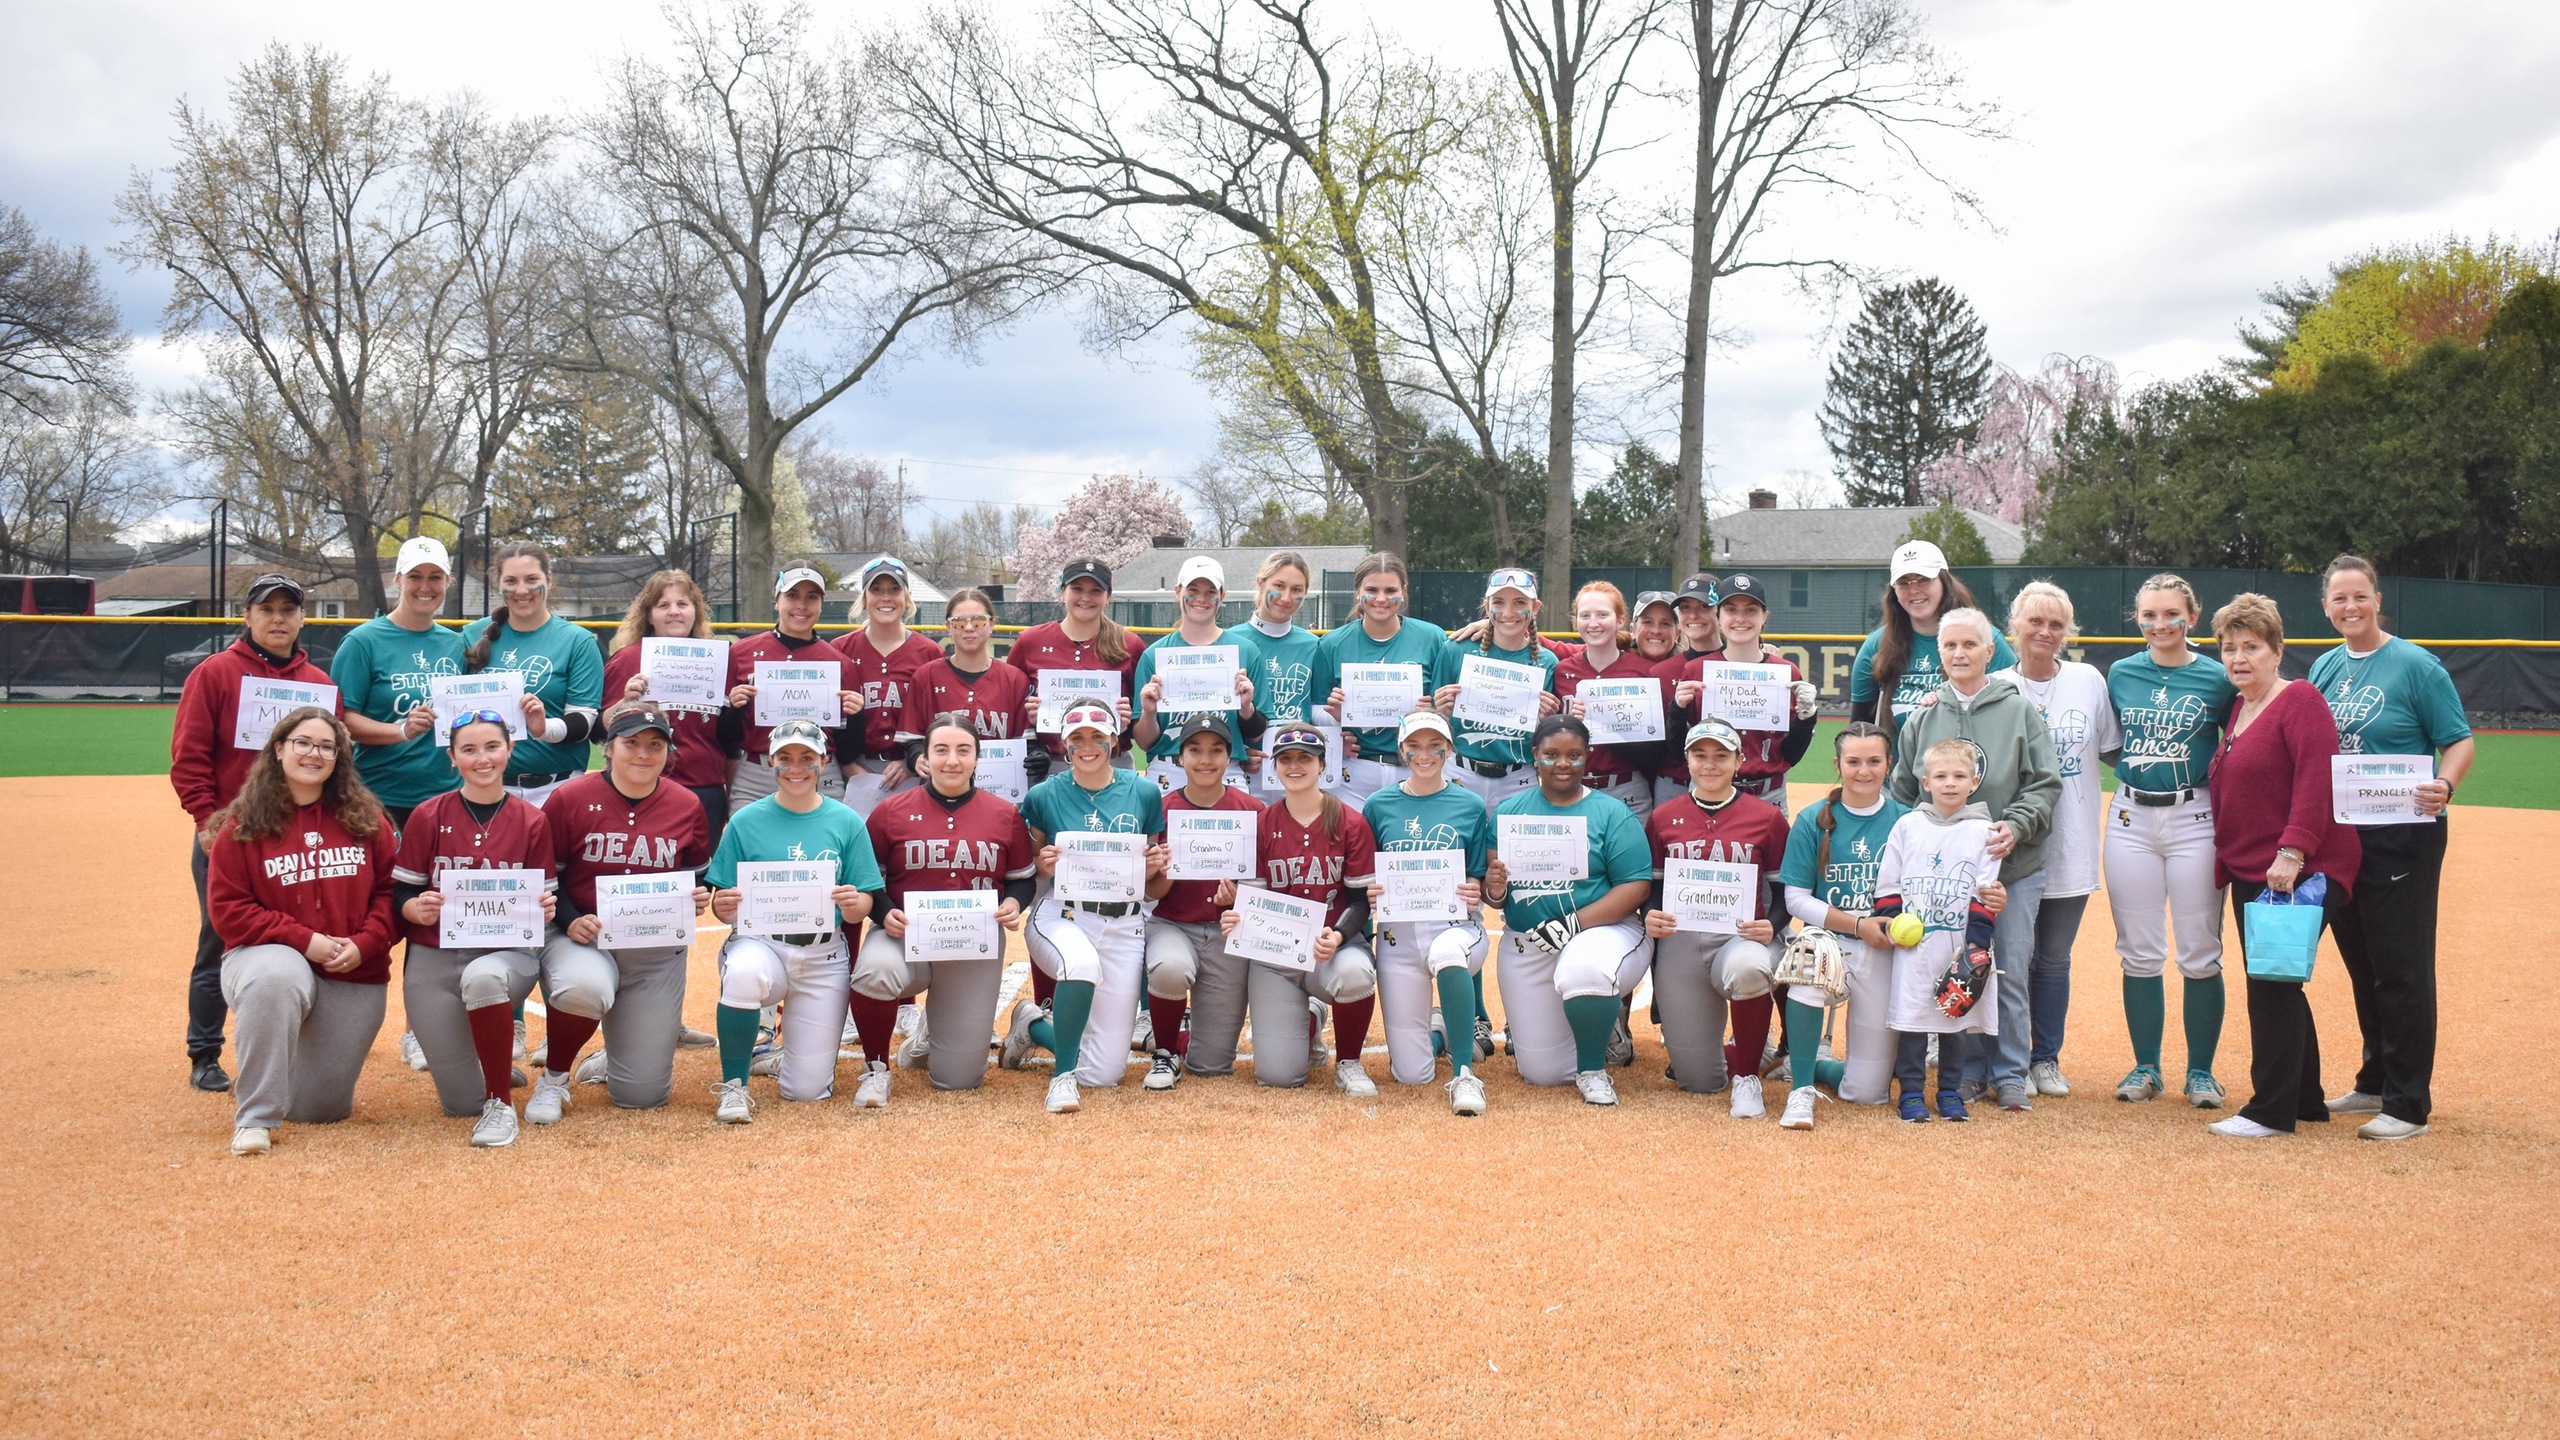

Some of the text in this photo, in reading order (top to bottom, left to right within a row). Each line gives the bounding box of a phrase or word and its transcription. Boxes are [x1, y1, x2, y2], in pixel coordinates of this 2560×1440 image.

[662, 645, 706, 658] I FIGHT FOR
[1175, 653, 1217, 665] I FIGHT FOR
[695, 664, 714, 674] Going
[775, 669, 819, 680] I FIGHT FOR
[1481, 665, 1523, 682] I FIGHT FOR
[1724, 669, 1768, 681] I FIGHT FOR
[1361, 671, 1401, 681] I FIGHT FOR
[454, 682, 499, 695] I FIGHT FOR
[1058, 678, 1099, 688] I FIGHT FOR
[1267, 677, 1304, 694] RIKE
[264, 687, 312, 703] I FIGHT FOR
[782, 689, 811, 701] MOM
[1597, 685, 1639, 696] I FIGHT FOR
[1720, 686, 1760, 697] My Dad
[1052, 693, 1072, 701] Susan
[1356, 690, 1402, 705] Everyone
[2151, 686, 2168, 708] EC
[1593, 702, 1627, 714] My sister
[1615, 711, 1631, 723] Dad
[2122, 708, 2194, 730] STRIKE
[2123, 729, 2191, 758] Cancer
[990, 748, 1005, 758] FOR
[2356, 763, 2406, 775] I FIGHT FOR
[2358, 787, 2414, 797] PRANGLEY
[1189, 819, 1233, 830] I FIGHT FOR
[1405, 815, 1422, 839] EC
[1519, 824, 1563, 835] I FIGHT FOR
[583, 832, 677, 868] DEAN
[1077, 840, 1122, 852] I FIGHT FOR
[1190, 839, 1222, 853] Grandma
[1851, 836, 1871, 861] EC
[905, 839, 1000, 872] DEAN
[1515, 845, 1561, 861] Everyone
[264, 846, 366, 879] DEAN COLLEGE
[1396, 859, 1442, 871] I FIGHT FOR
[761, 870, 809, 882] I FIGHT FOR
[1268, 856, 1344, 888] DEAN
[1687, 868, 1733, 882] I FIGHT FOR
[466, 879, 517, 891] I FIGHT FOR
[620, 881, 670, 895] I FIGHT FOR
[1395, 878, 1442, 897] Everyone
[1902, 876, 1971, 899] STRIKE
[1678, 886, 1728, 906] Grandma
[464, 901, 506, 917] MAHA
[927, 898, 974, 909] I FIGHT FOR
[1257, 897, 1303, 917] I FIGHT FOR
[642, 906, 677, 915] Connie
[936, 914, 963, 922] Great
[1250, 914, 1265, 926] My
[1260, 941, 1291, 950] STRIKEOUT
[1260, 945, 1283, 953] CANCER
